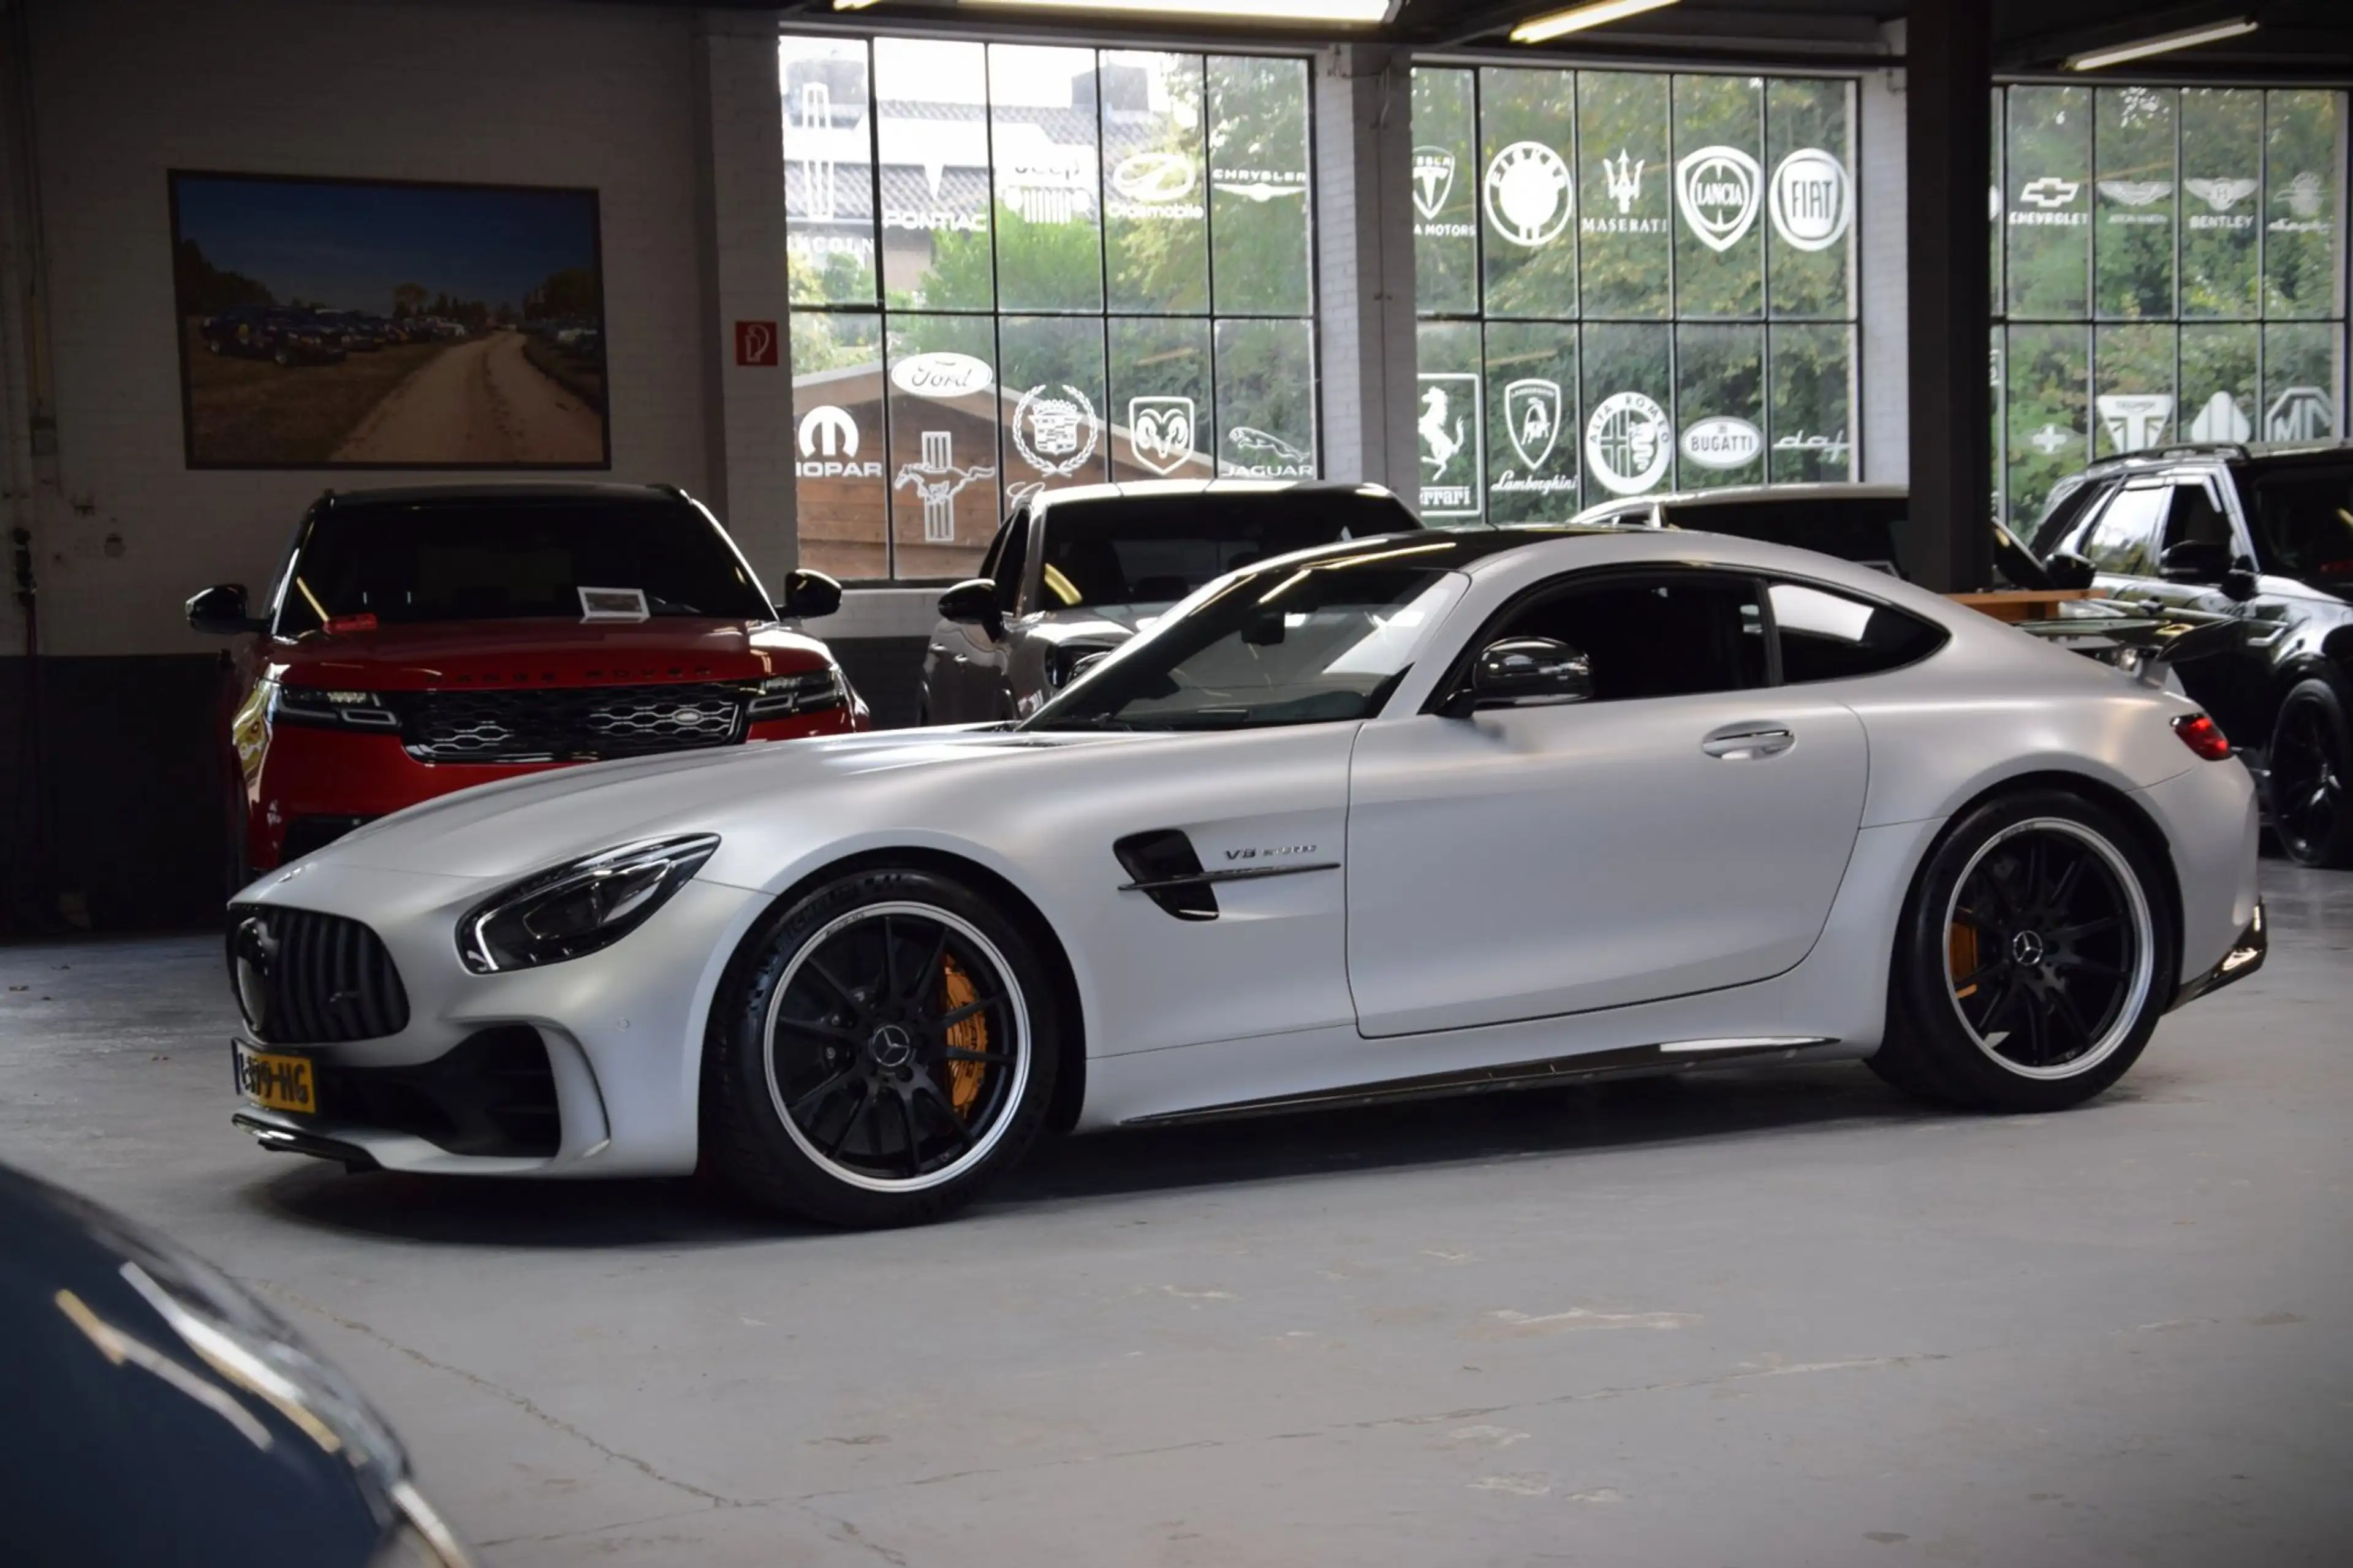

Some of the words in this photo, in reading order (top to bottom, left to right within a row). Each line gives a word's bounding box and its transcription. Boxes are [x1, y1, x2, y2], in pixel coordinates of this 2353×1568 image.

[1416, 156, 1451, 166] ESLA
[1212, 168, 1306, 182] CHRYSLER
[1696, 182, 1745, 206] LANCIA
[1792, 180, 1833, 219] FIAT
[1106, 203, 1205, 220] Oldsmobile
[2009, 212, 2088, 226] CHEVROLET
[882, 210, 987, 231] PONTIAC
[1582, 218, 1667, 233] MASERATI
[2189, 215, 2254, 230] BENTLEY
[1425, 224, 1476, 237] MOTORS
[787, 235, 874, 254] INCOLN
[912, 360, 971, 387] Ford
[1589, 406, 1613, 444] ALFA
[1625, 395, 1670, 444] ROMEO
[1691, 435, 1754, 452] BUGATTI
[796, 461, 883, 477] OPAR
[1221, 464, 1314, 477] JAGUAR
[1491, 470, 1578, 495] Lamborghini
